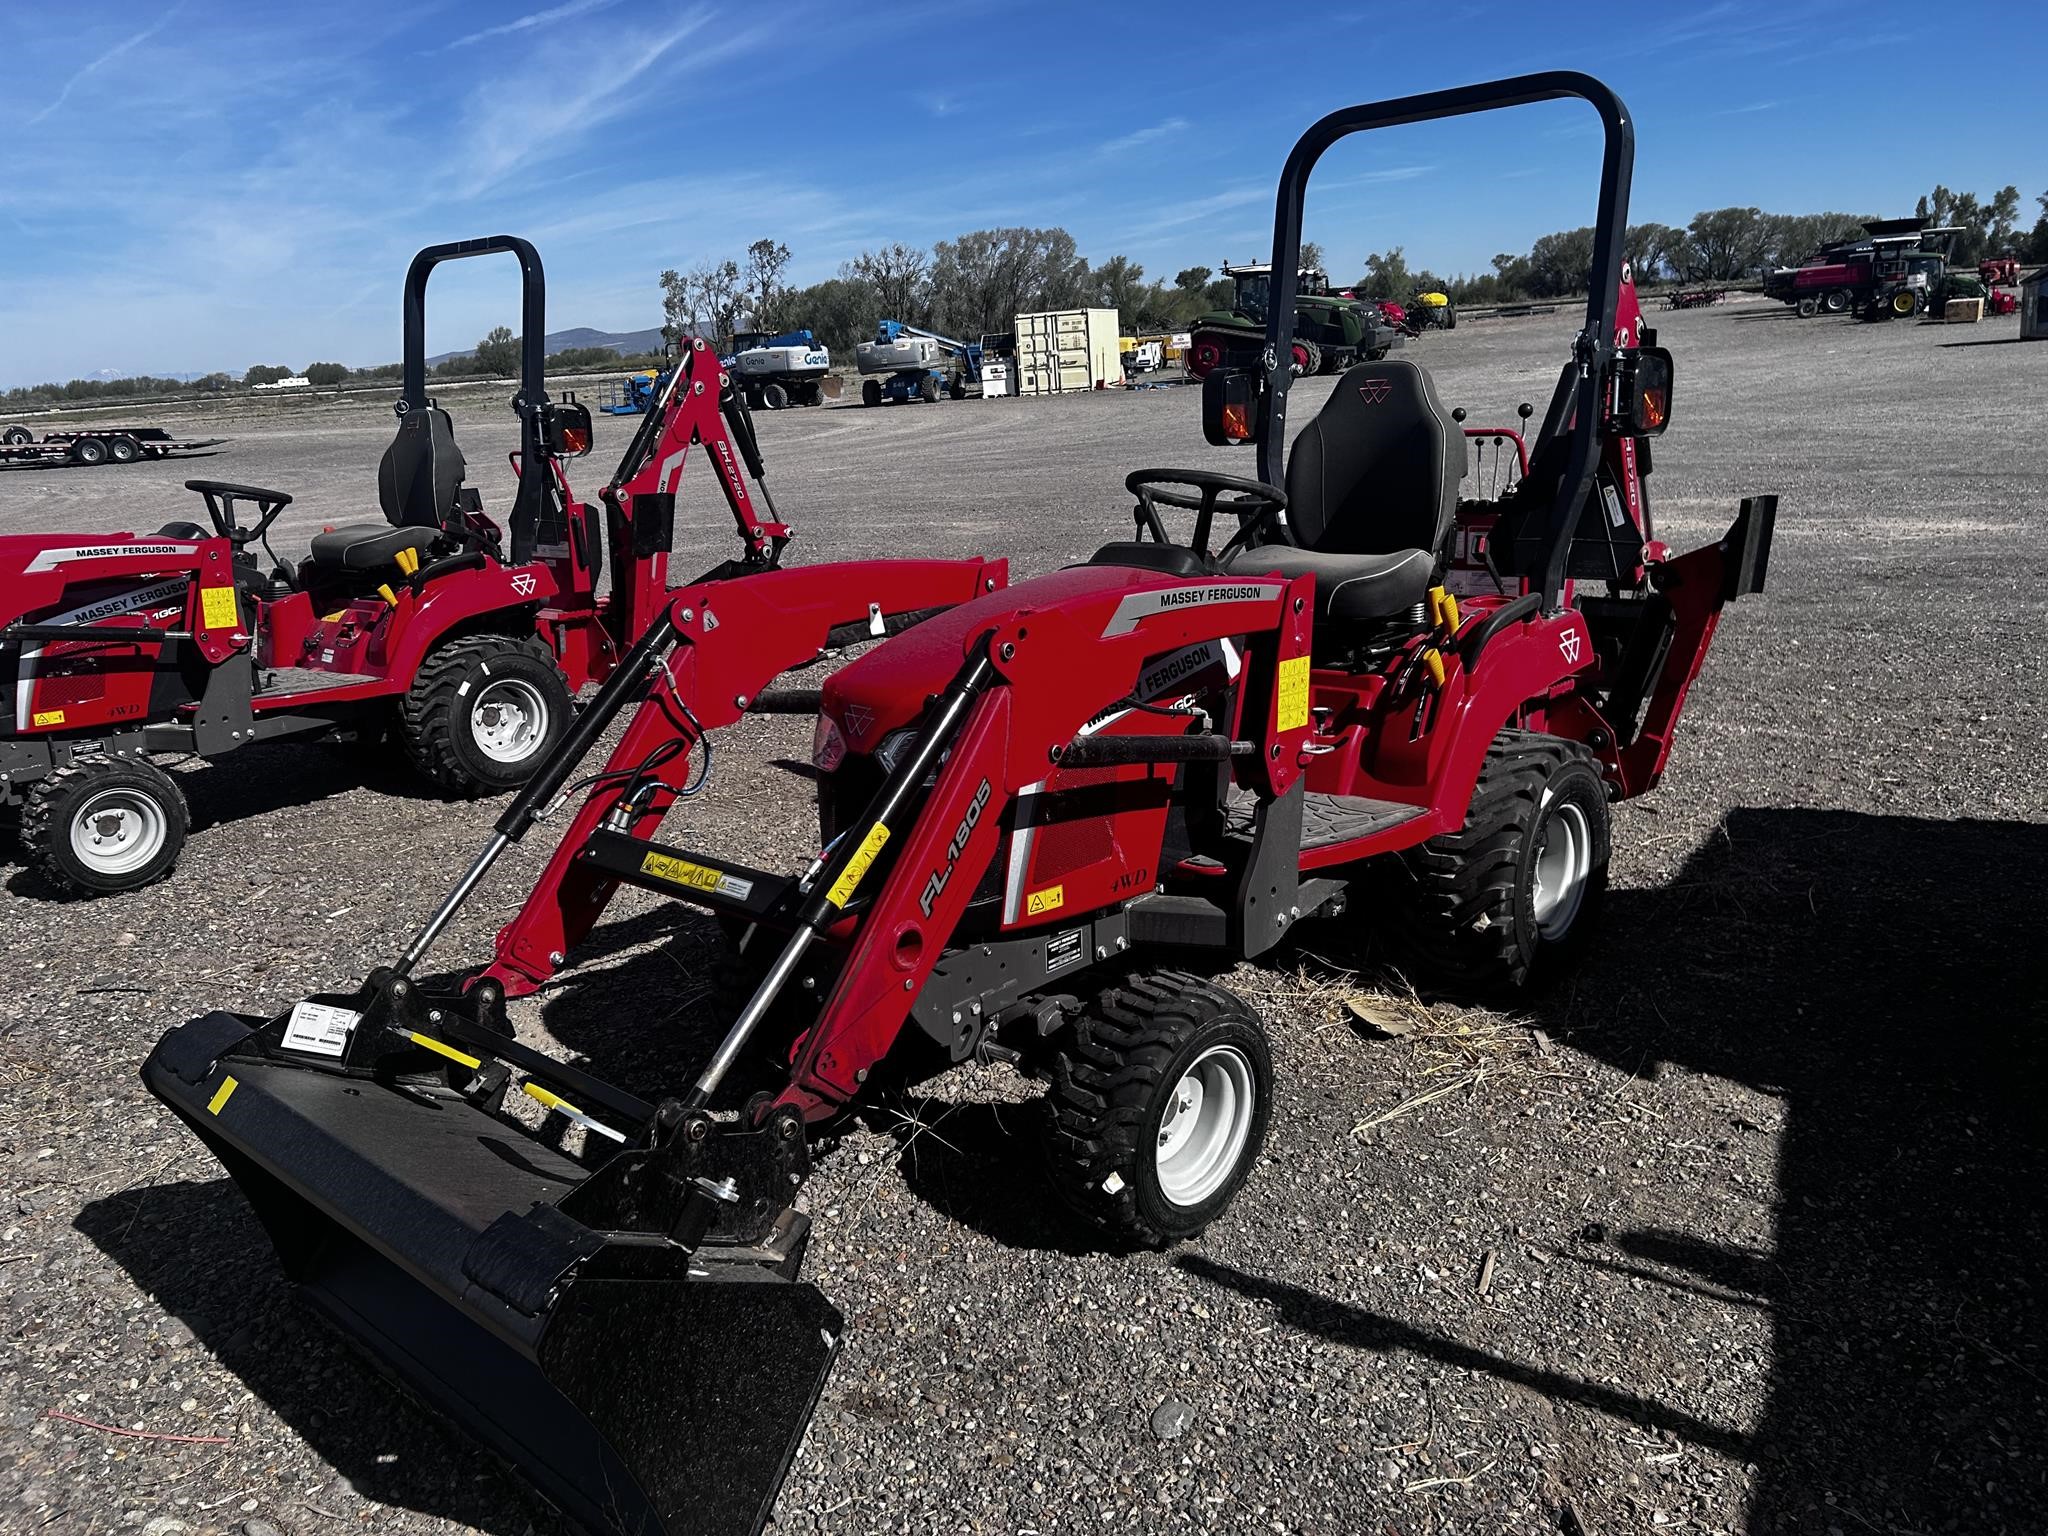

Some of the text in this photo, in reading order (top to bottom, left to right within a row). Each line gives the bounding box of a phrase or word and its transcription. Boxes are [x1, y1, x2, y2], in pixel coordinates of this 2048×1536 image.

[719, 355, 737, 368] enie
[745, 357, 765, 366] Genie
[804, 353, 828, 365] Genie
[1625, 437, 1636, 506] H.2720
[76, 545, 177, 557] MASSEY FERGUSON
[75, 581, 190, 623] MASSEY FERGUSO
[1160, 586, 1261, 607] MASSEY FERGUSON
[1144, 644, 1211, 693] FERGUSON
[107, 703, 140, 718] 4WD
[919, 777, 992, 919] FL.1805
[1110, 868, 1148, 893] 4WD
